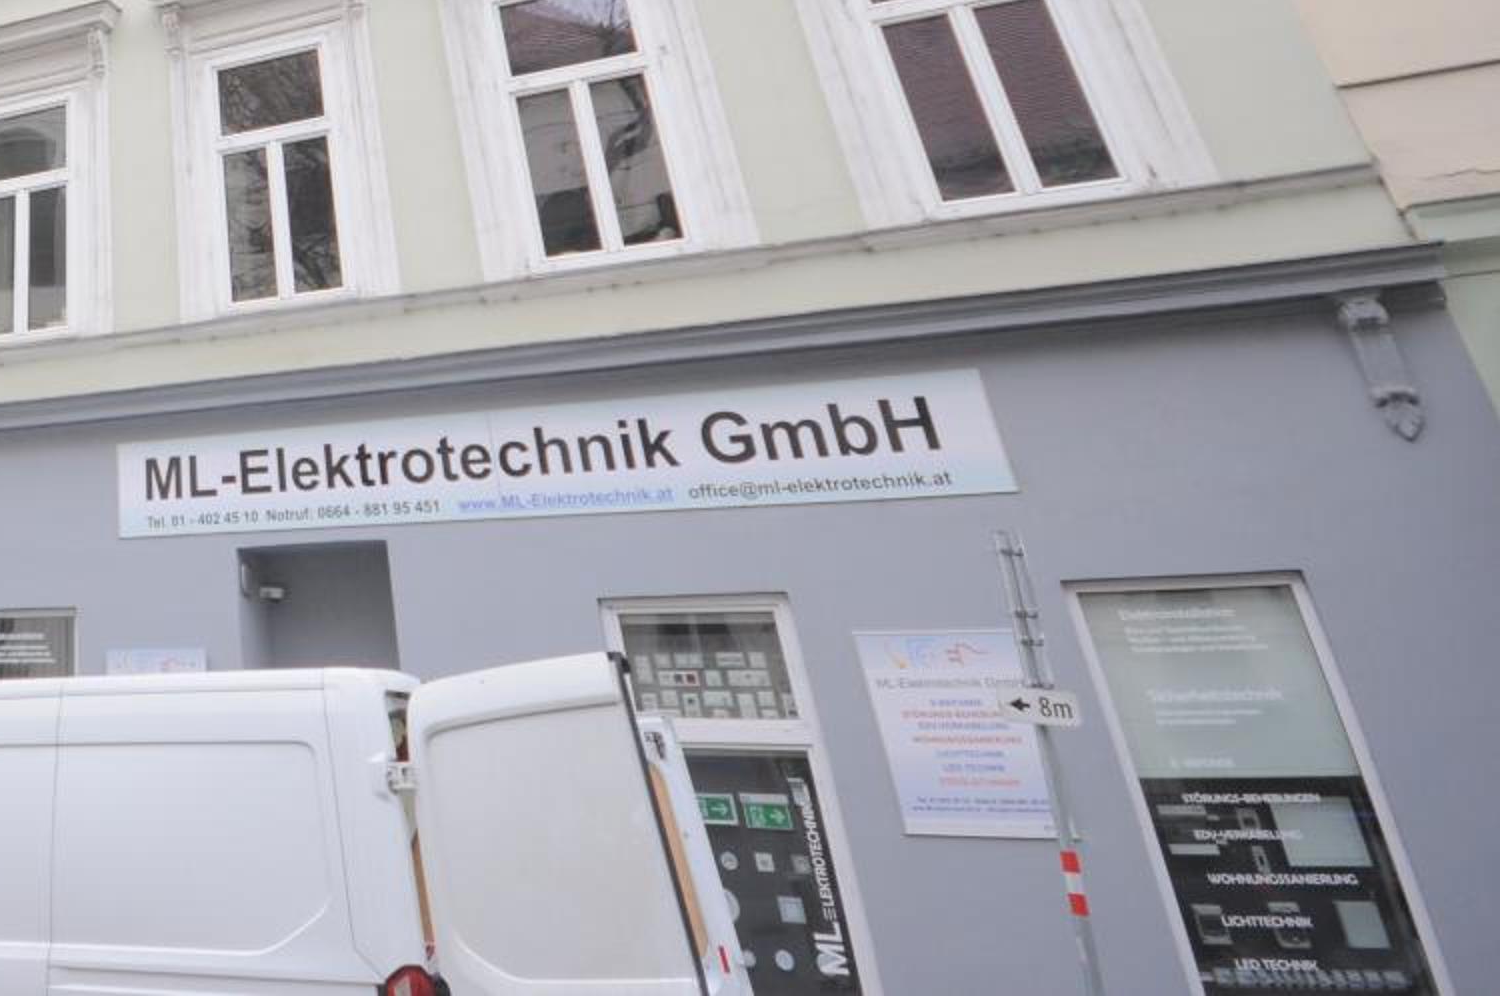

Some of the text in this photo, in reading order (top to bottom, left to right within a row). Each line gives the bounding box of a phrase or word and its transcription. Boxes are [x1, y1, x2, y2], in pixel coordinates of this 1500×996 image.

[145, 395, 942, 502] ML-Elektrotechnik GmbH
[224, 511, 240, 522] 45
[414, 500, 440, 512] 451
[688, 471, 953, 500] office@ml-elektrotechnik.at
[1037, 696, 1074, 720] 8m
[1220, 915, 1314, 928] LICHTTECHNIK
[812, 921, 850, 977] ML
[1235, 958, 1319, 973] LED TECHNIK
